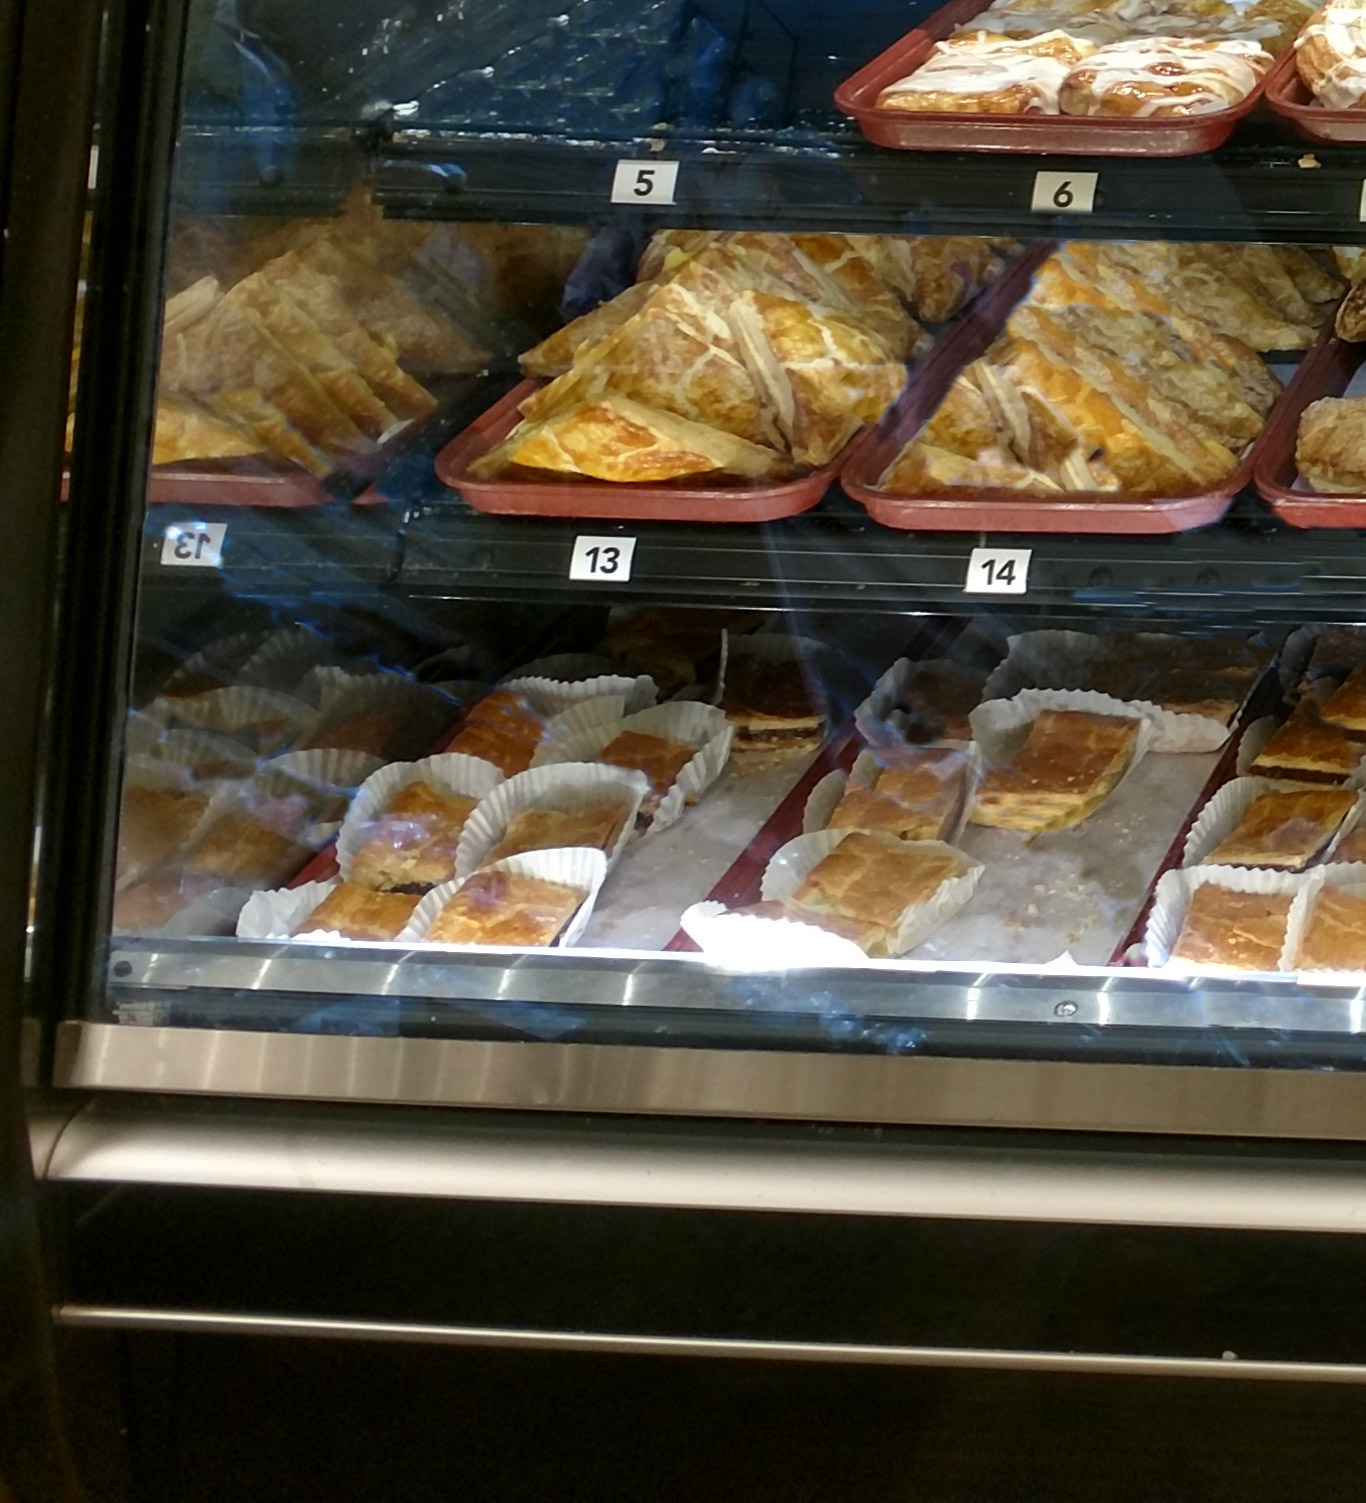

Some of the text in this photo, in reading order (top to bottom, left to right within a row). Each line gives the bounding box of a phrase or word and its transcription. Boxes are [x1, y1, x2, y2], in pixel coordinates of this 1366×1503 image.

[634, 170, 655, 197] 5
[1054, 182, 1074, 208] 6
[586, 547, 621, 574] 13
[981, 560, 1016, 586] 14
